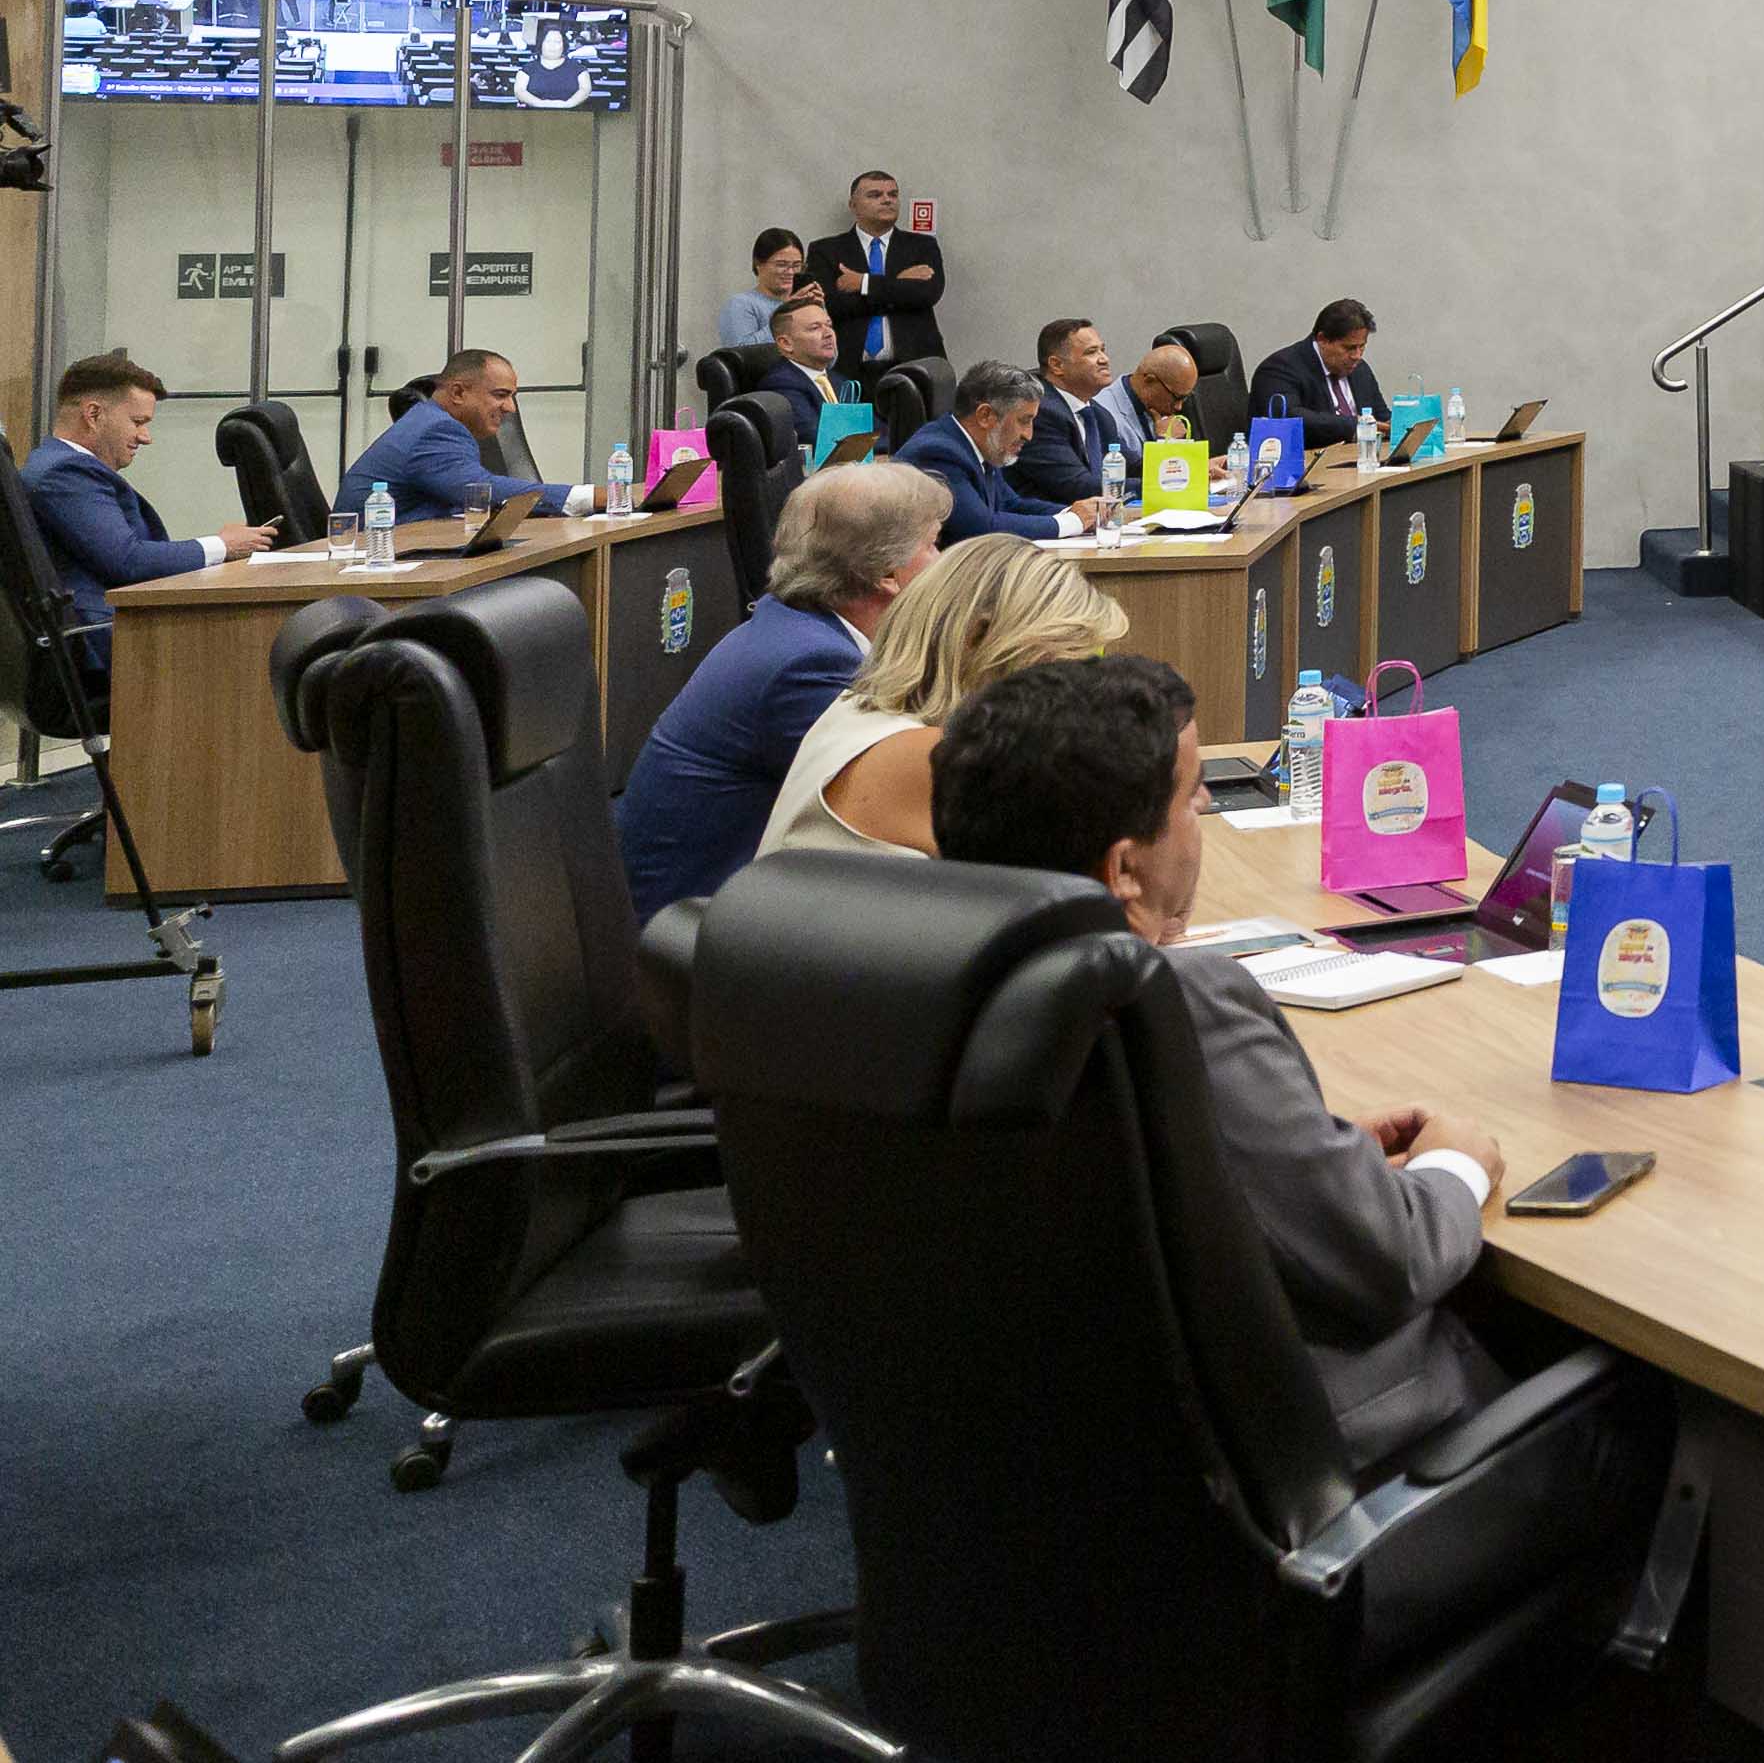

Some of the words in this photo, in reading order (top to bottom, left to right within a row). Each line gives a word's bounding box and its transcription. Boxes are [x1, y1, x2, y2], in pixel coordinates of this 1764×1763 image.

[467, 264, 518, 273] APERTE
[521, 264, 529, 273] E
[466, 275, 529, 285] EMPURRE
